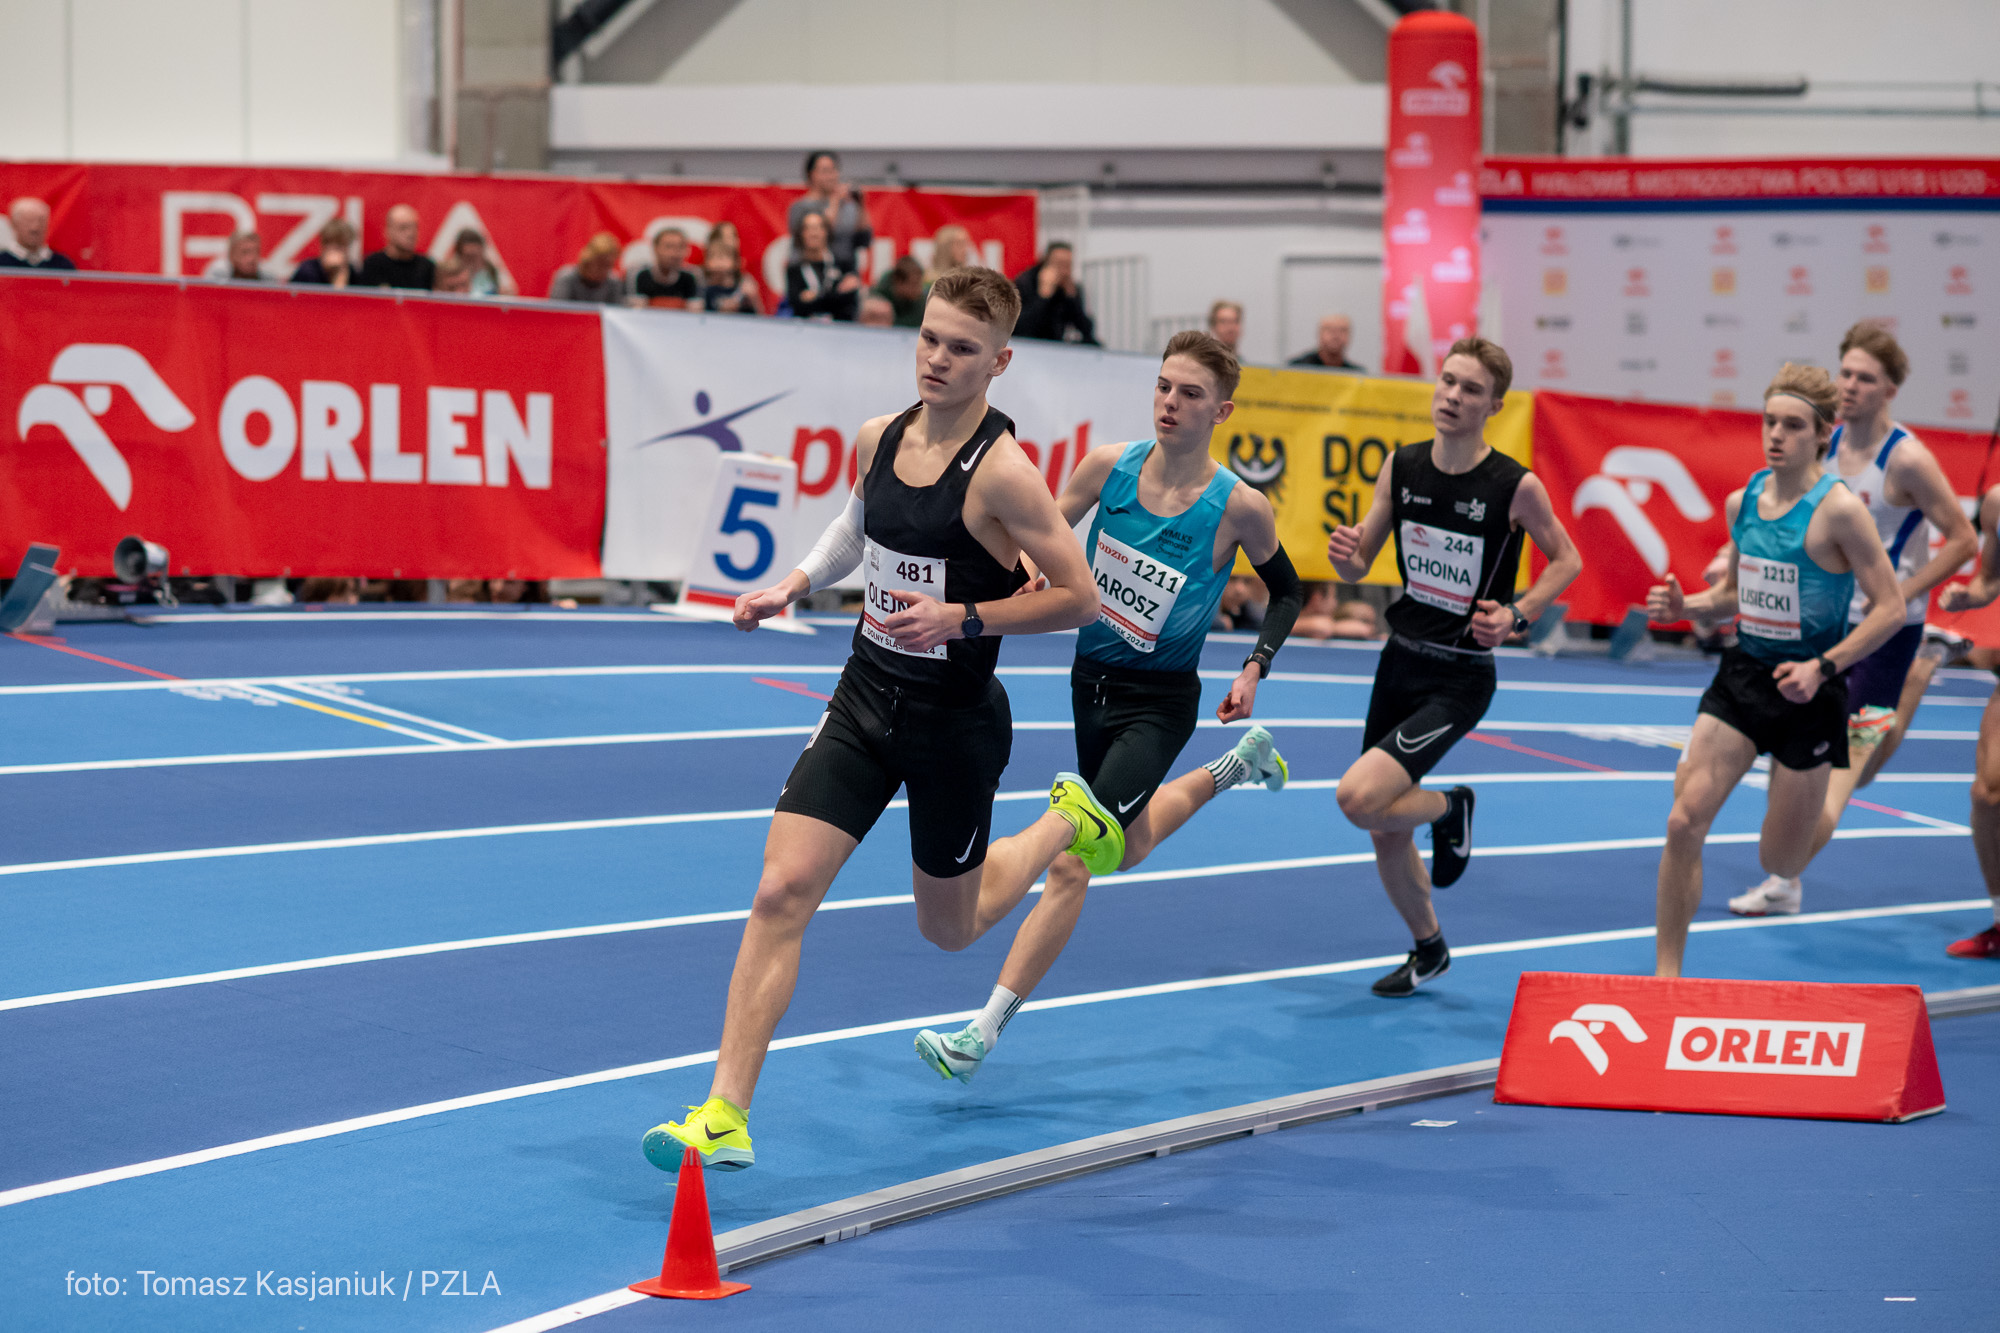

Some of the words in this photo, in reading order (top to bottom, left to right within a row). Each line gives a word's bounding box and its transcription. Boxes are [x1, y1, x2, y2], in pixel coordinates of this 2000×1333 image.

[218, 374, 553, 490] ORLEN
[713, 486, 780, 583] 5
[1161, 528, 1193, 544] WMLKS
[1444, 536, 1474, 556] 244
[896, 560, 934, 584] 481
[1132, 559, 1179, 594] 1211
[1407, 554, 1472, 587] CHOINA
[1764, 566, 1796, 584] 1213
[1741, 586, 1791, 613] LISIECKI
[867, 627, 884, 644] DOLNY
[1126, 633, 1146, 649] 2024
[1680, 1026, 1850, 1067] ORLEN
